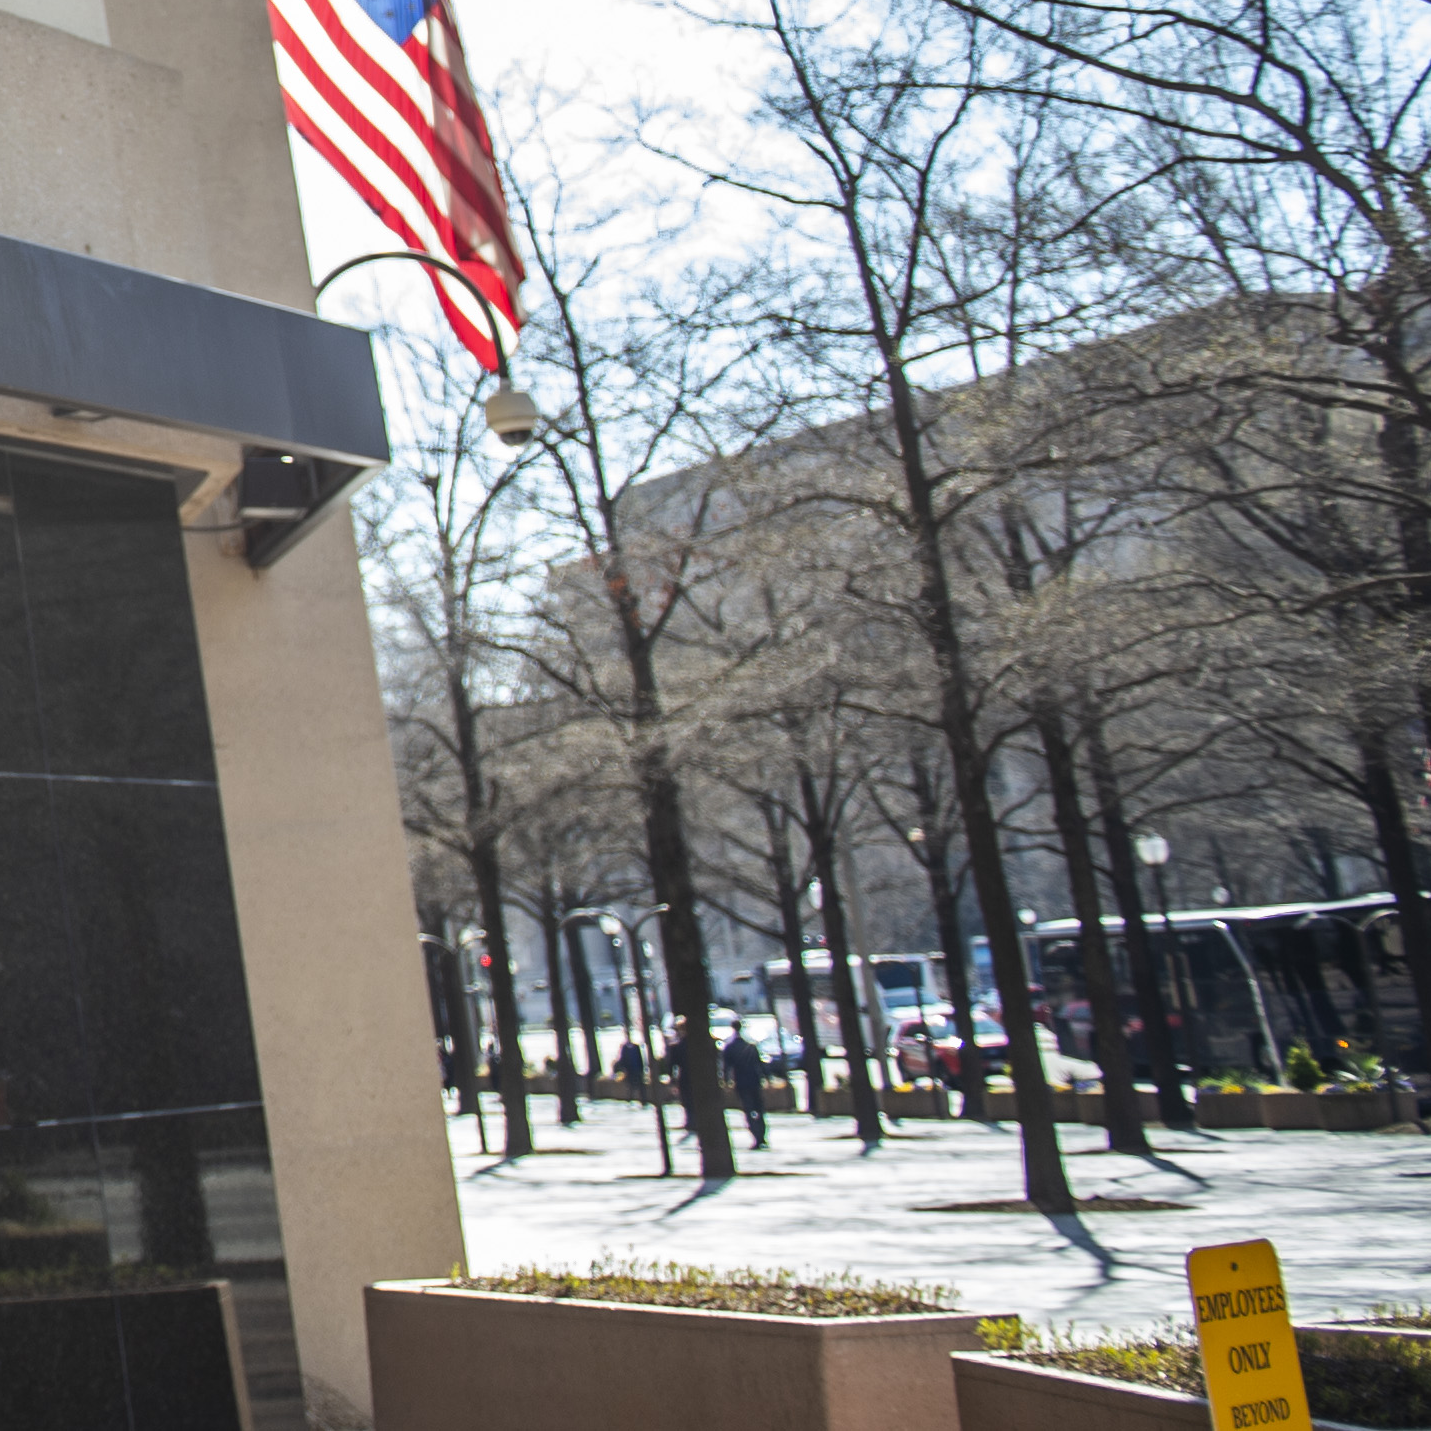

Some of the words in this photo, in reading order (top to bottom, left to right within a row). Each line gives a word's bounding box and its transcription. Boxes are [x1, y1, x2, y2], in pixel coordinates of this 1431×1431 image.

[1196, 1284, 1286, 1323] EMPLOYEES
[1228, 1340, 1272, 1375] ONLY
[1230, 1397, 1291, 1429] BEYOND
